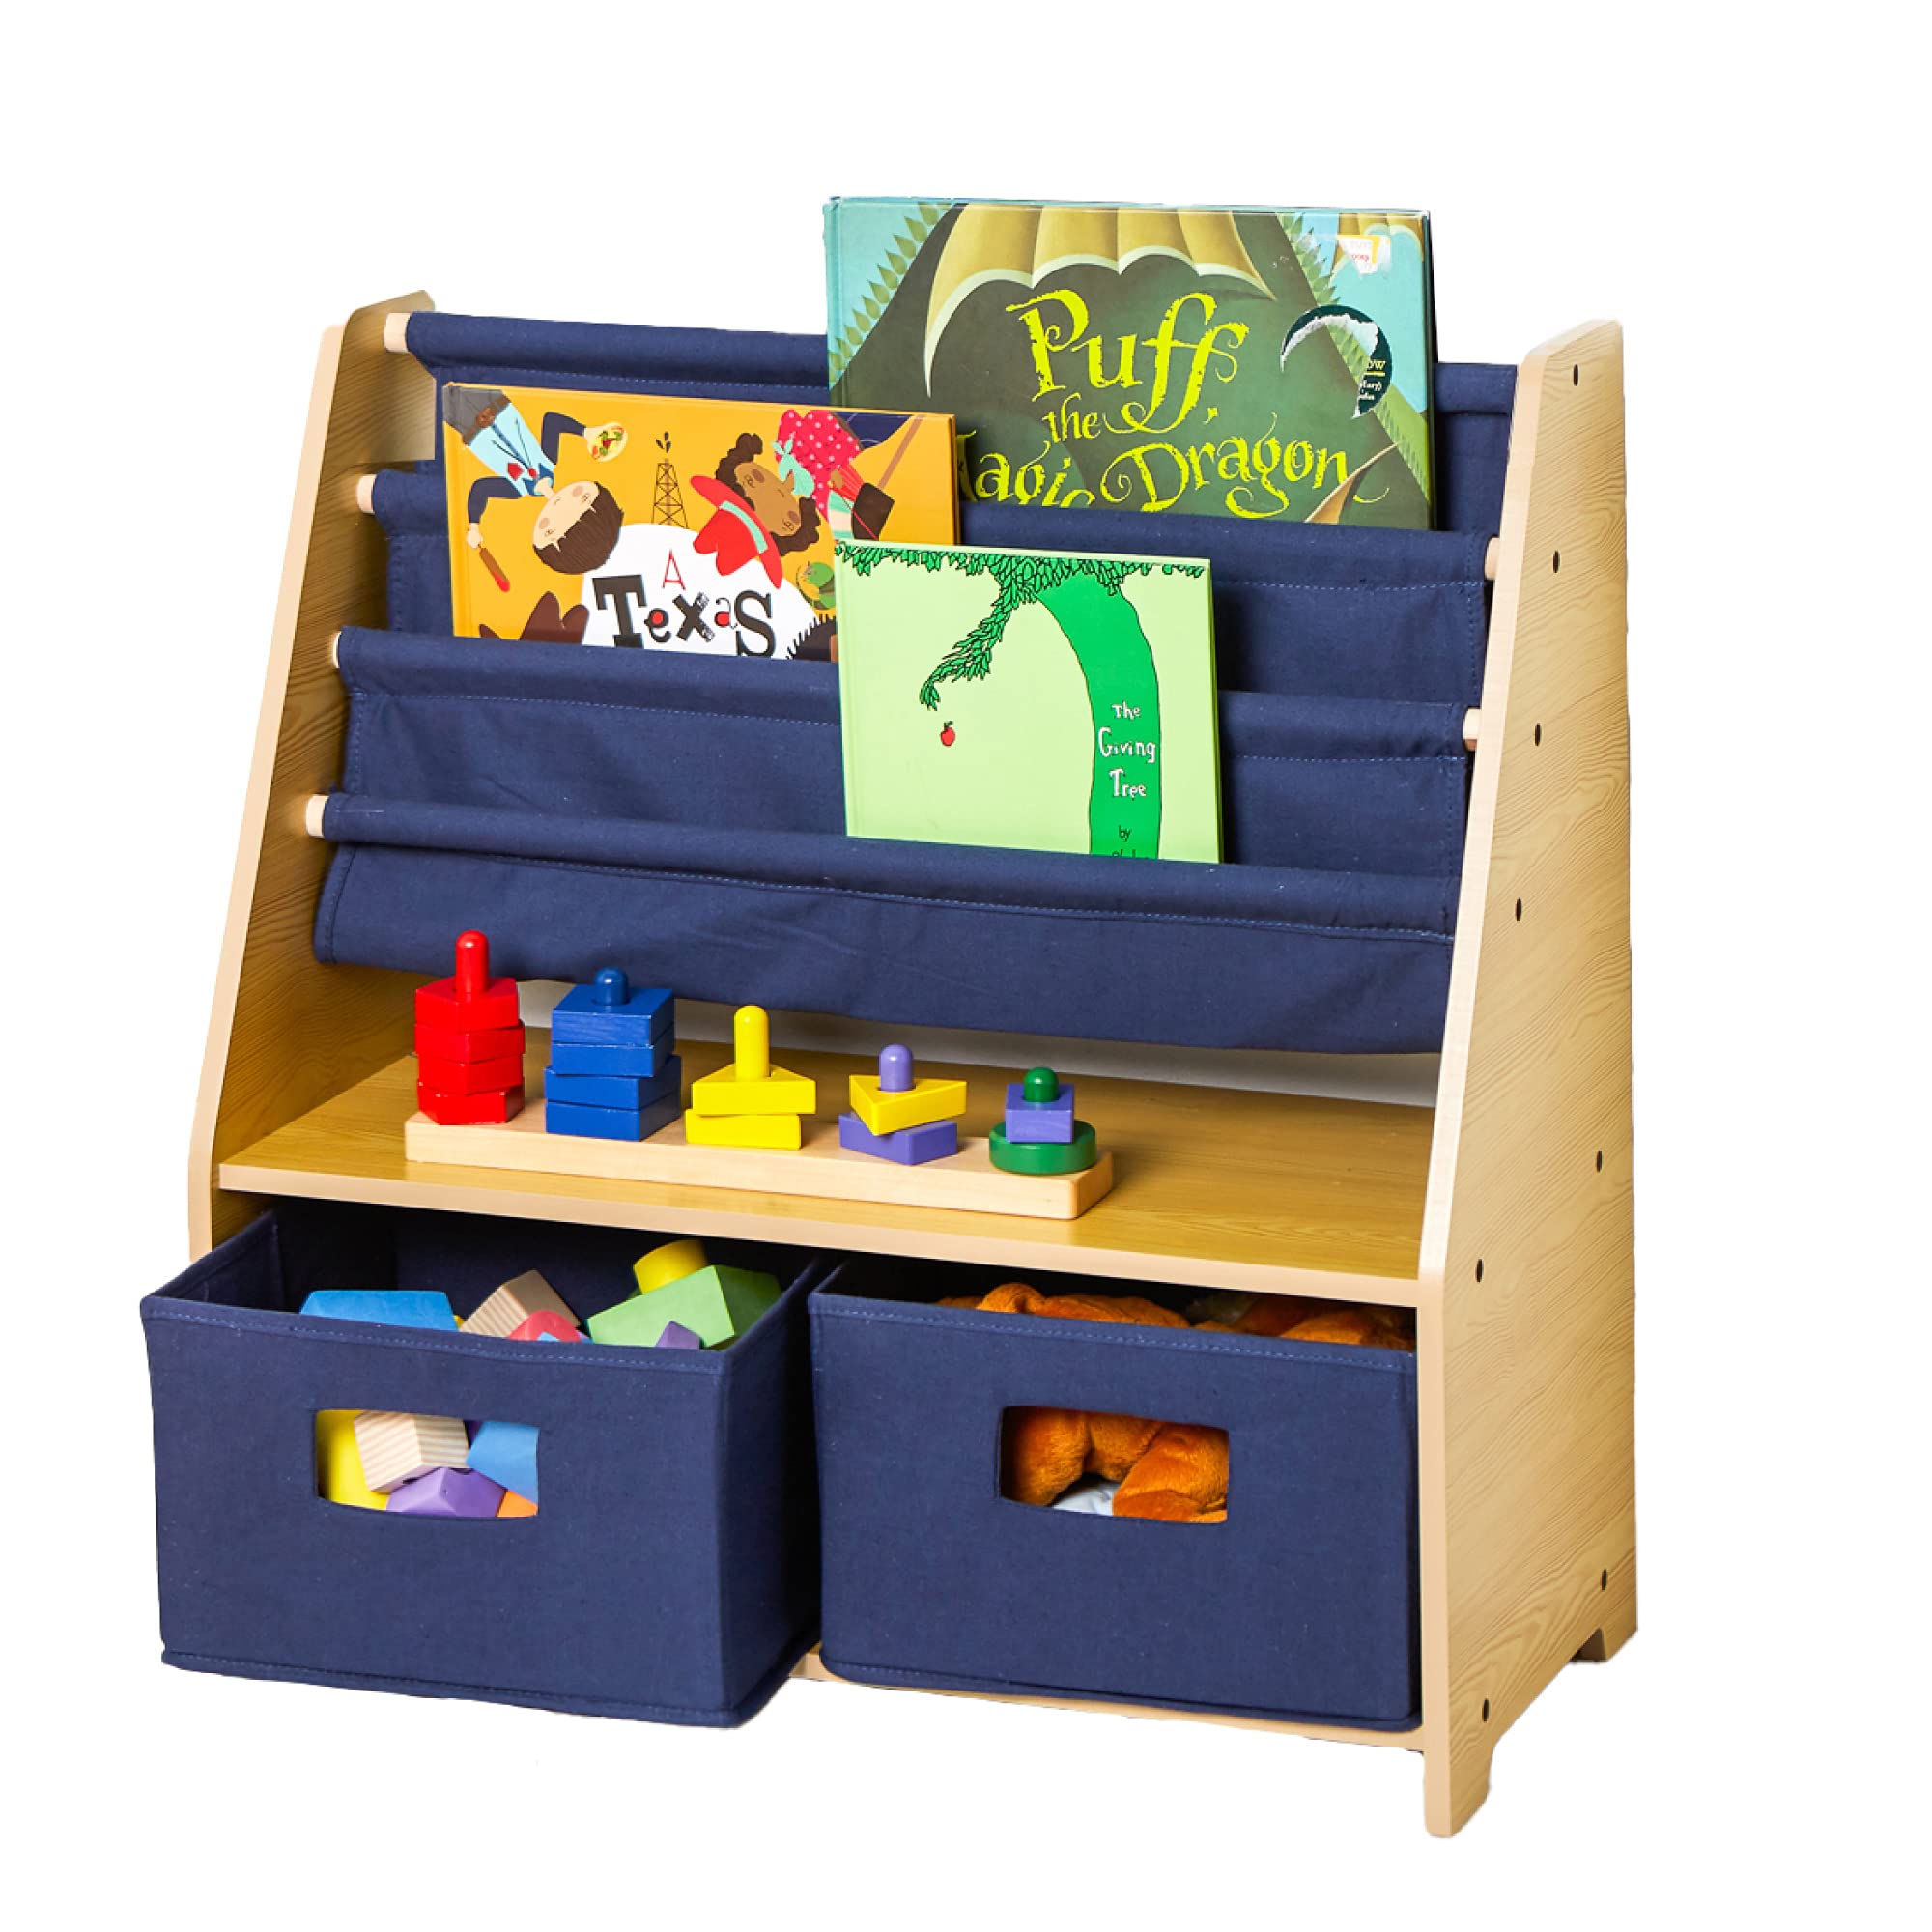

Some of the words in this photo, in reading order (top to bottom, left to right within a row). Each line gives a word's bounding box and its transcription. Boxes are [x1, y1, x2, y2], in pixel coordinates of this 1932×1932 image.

[1043, 392, 1103, 444] the
[1100, 412, 1390, 518] Dragon
[661, 549, 687, 591] A
[1112, 701, 1141, 720] The
[1097, 726, 1156, 764] Giving
[1109, 768, 1147, 798] Tree
[1118, 825, 1132, 842] by
